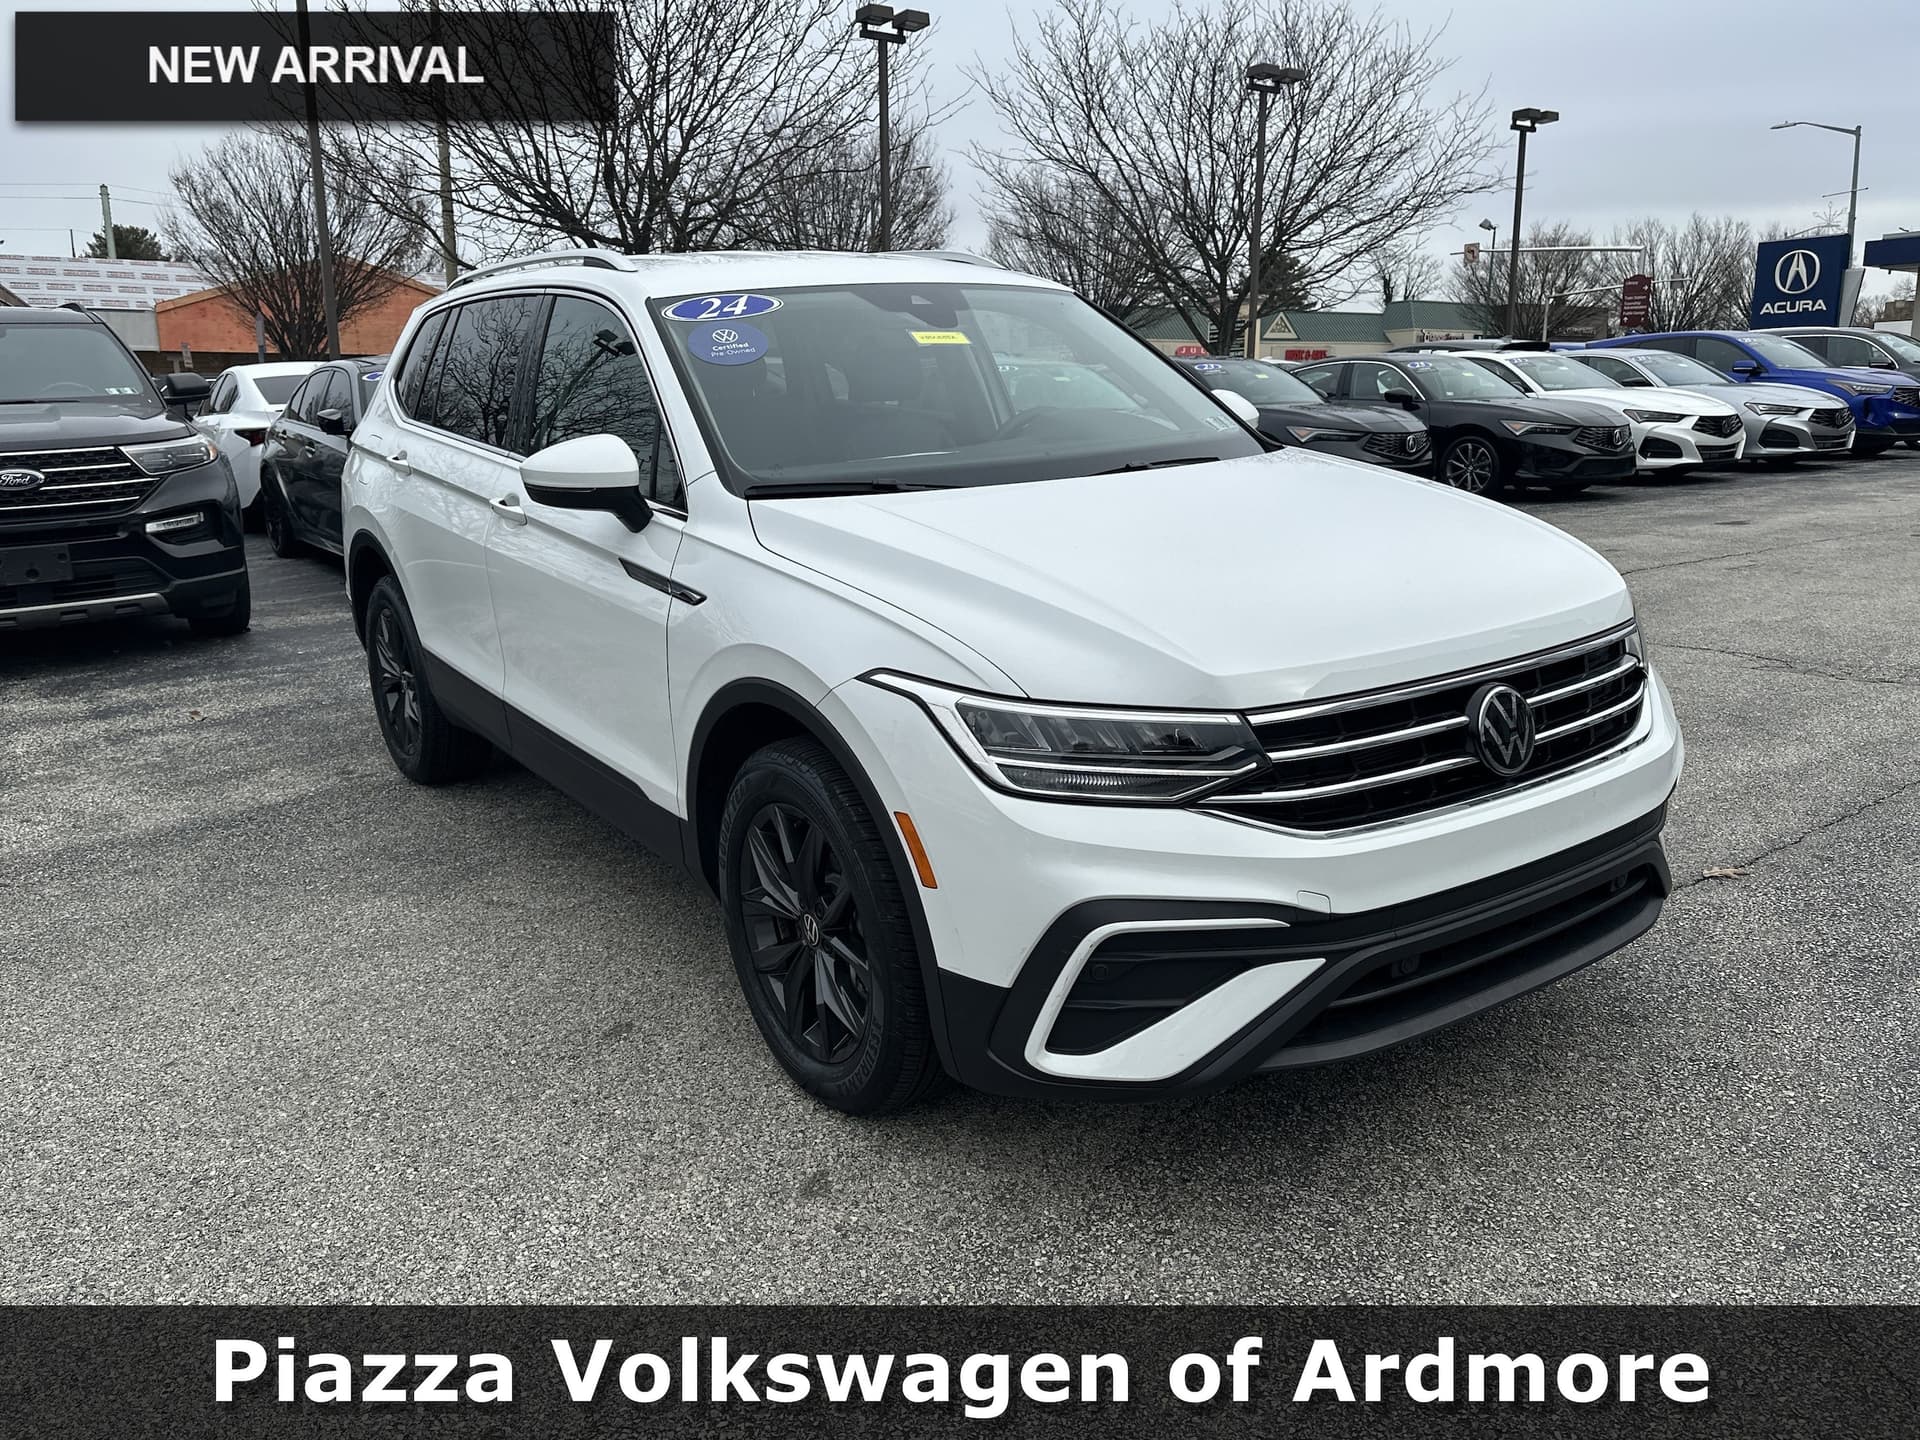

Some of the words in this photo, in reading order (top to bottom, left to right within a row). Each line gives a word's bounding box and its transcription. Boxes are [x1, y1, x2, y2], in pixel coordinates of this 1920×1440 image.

[697, 295, 749, 319] 24
[1759, 299, 1827, 315] ACURA
[712, 342, 749, 352] Certified
[1, 473, 30, 486] Ford
